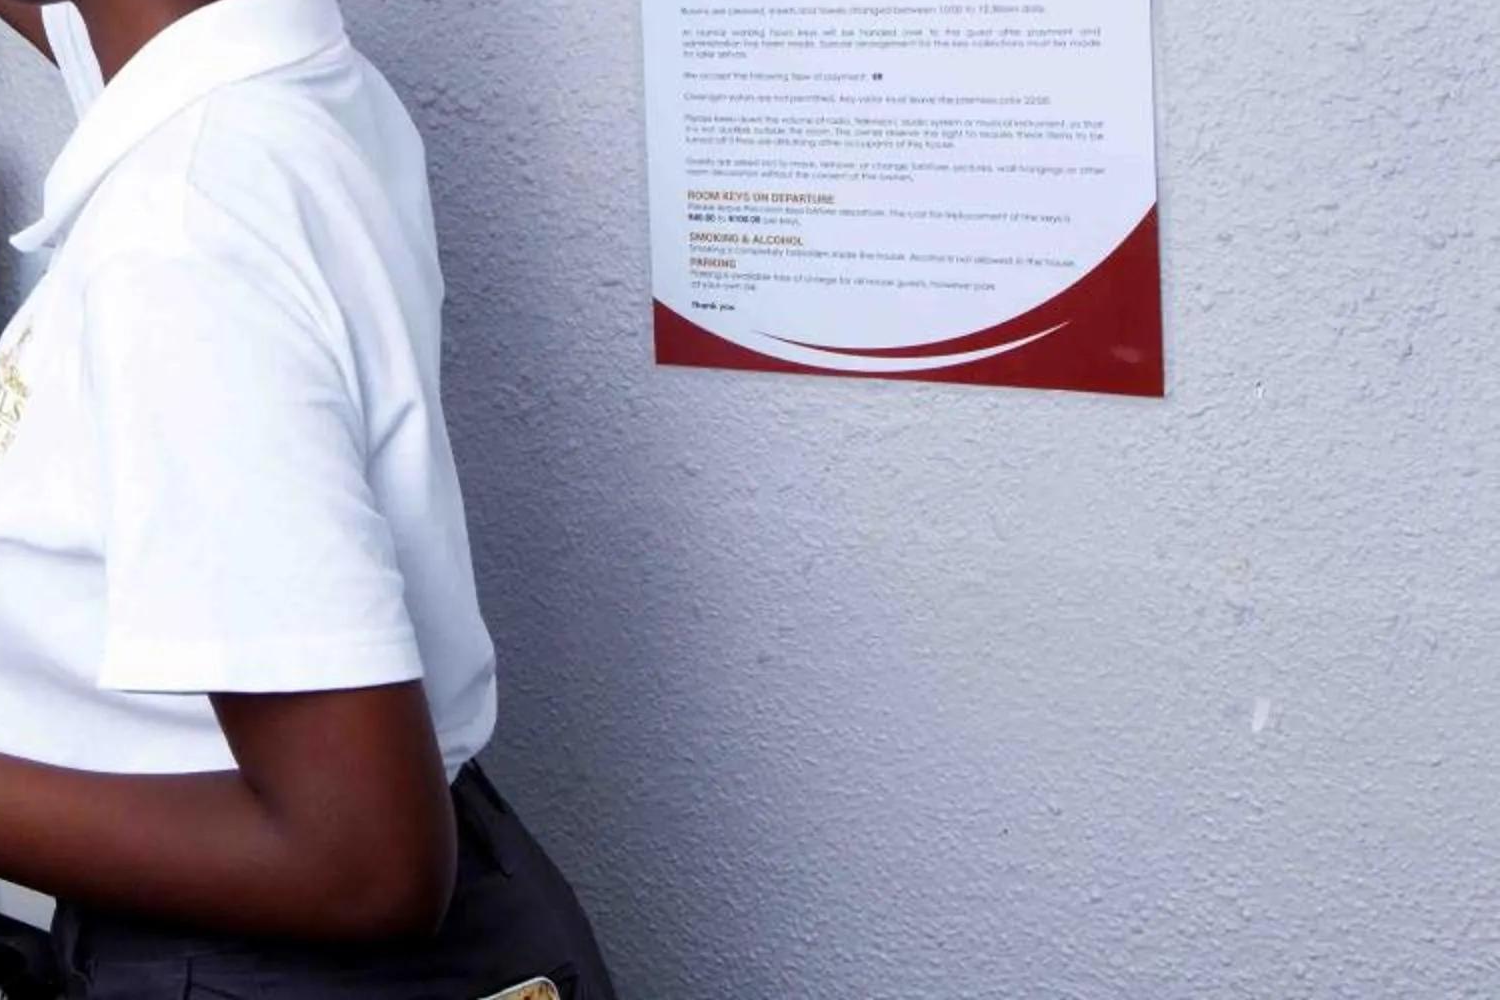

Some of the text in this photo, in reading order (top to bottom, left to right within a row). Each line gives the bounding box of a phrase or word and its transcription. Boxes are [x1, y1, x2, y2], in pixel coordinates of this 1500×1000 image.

[687, 190, 835, 205] ROOM KEYS ON DEPARTURE
[689, 232, 739, 244] SMOKING
[752, 233, 804, 246] ALCOHOL
[690, 257, 737, 269] PARKING
